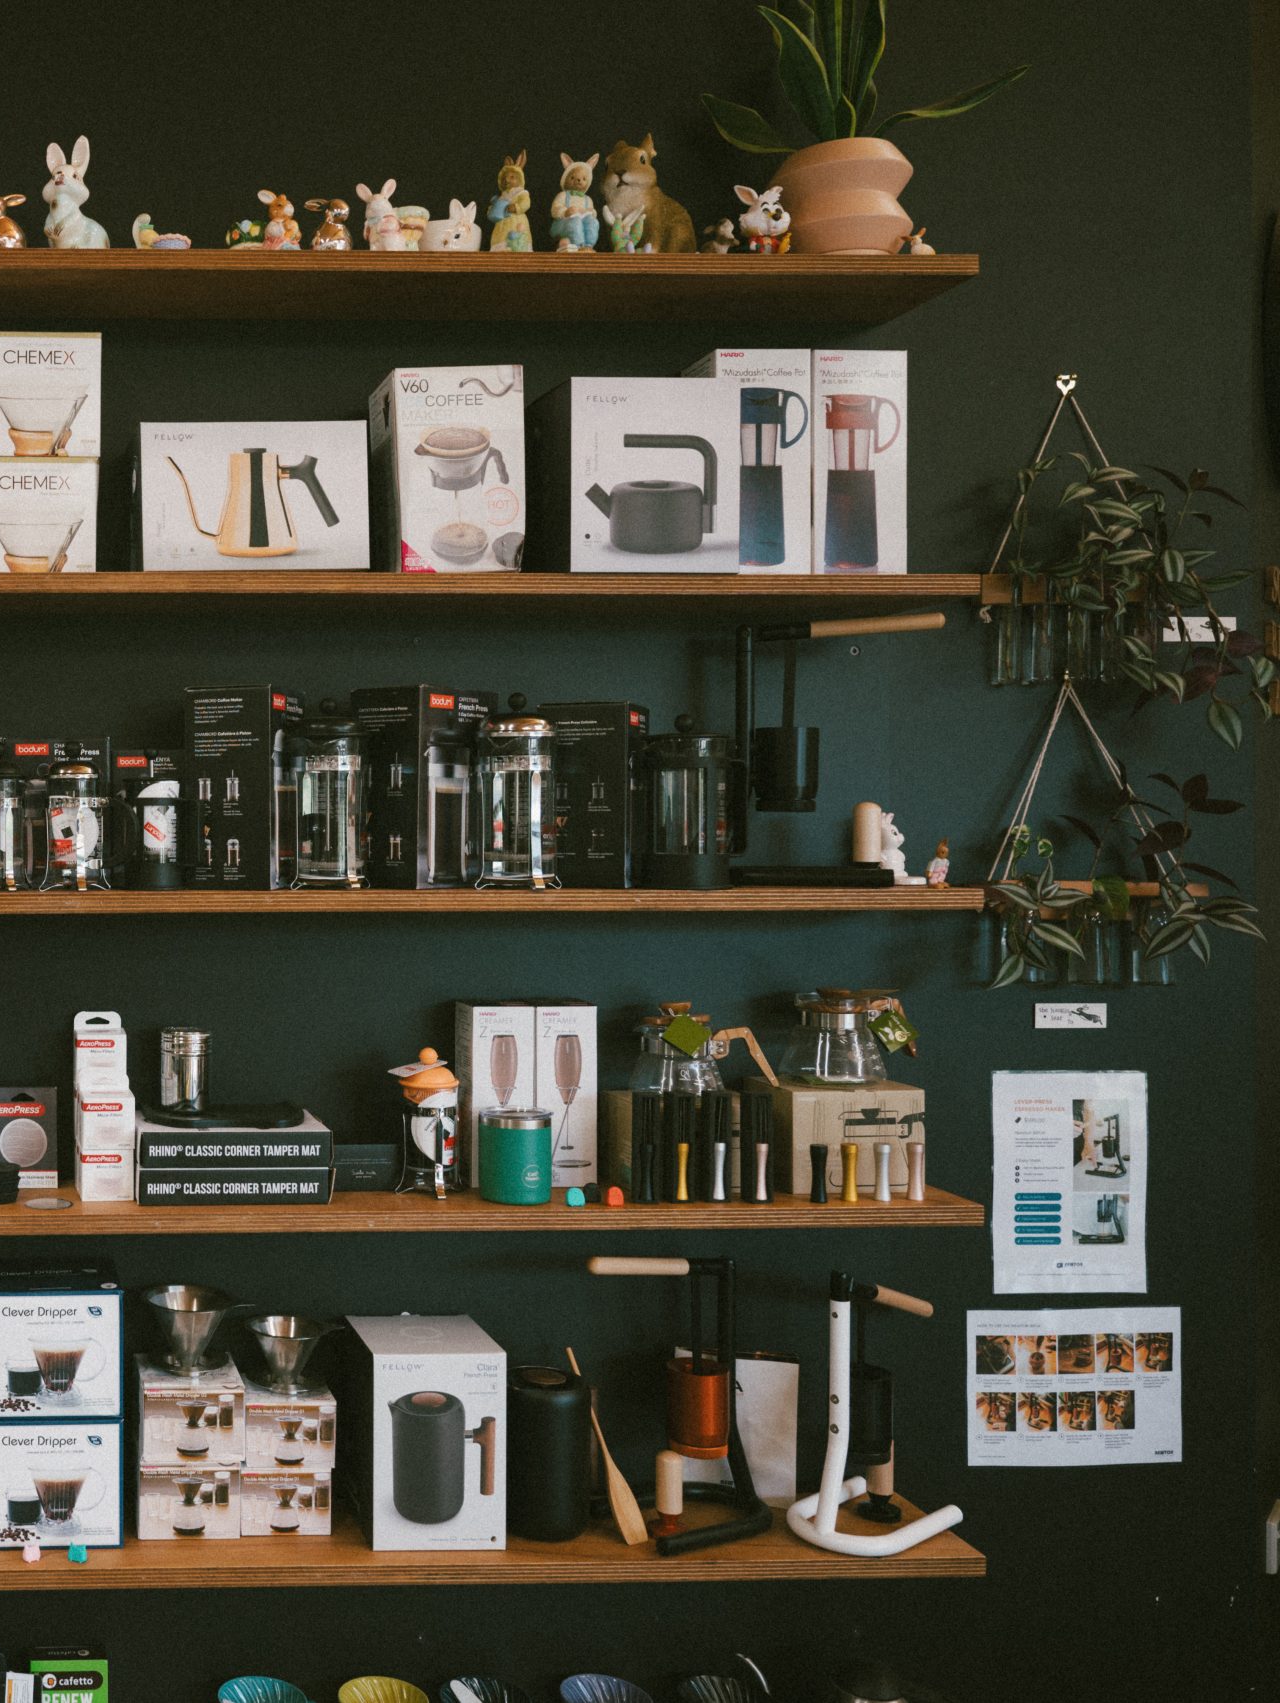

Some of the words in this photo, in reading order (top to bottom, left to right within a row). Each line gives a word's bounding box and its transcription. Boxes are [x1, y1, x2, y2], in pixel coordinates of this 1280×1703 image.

[2, 349, 76, 366] CHEMEX
[766, 368, 793, 377] Coffee
[400, 379, 429, 393] V60
[425, 393, 484, 407] COFFEE
[586, 395, 628, 405] FELLOW
[154, 432, 194, 442] FELLOW
[431, 697, 453, 706] bodum
[458, 702, 475, 711] French
[475, 704, 489, 712] Press
[17, 745, 47, 753] bodum
[185, 1145, 222, 1157] CLASSIC
[224, 1145, 261, 1157] CORNER
[262, 1145, 299, 1156] TAMPER
[301, 1144, 321, 1156] MAT
[183, 1183, 221, 1195] CLASSIC
[222, 1183, 260, 1195] CORNER
[261, 1183, 298, 1194] TAMPER
[300, 1182, 319, 1194] MAT
[1, 1306, 35, 1317] Clever
[37, 1306, 78, 1319] Dripper
[382, 1364, 422, 1373] FELLOW
[477, 1363, 498, 1372] Clara
[1, 1435, 35, 1446] Clever
[37, 1435, 78, 1448] Dripper
[58, 1677, 94, 1687] cafetto
